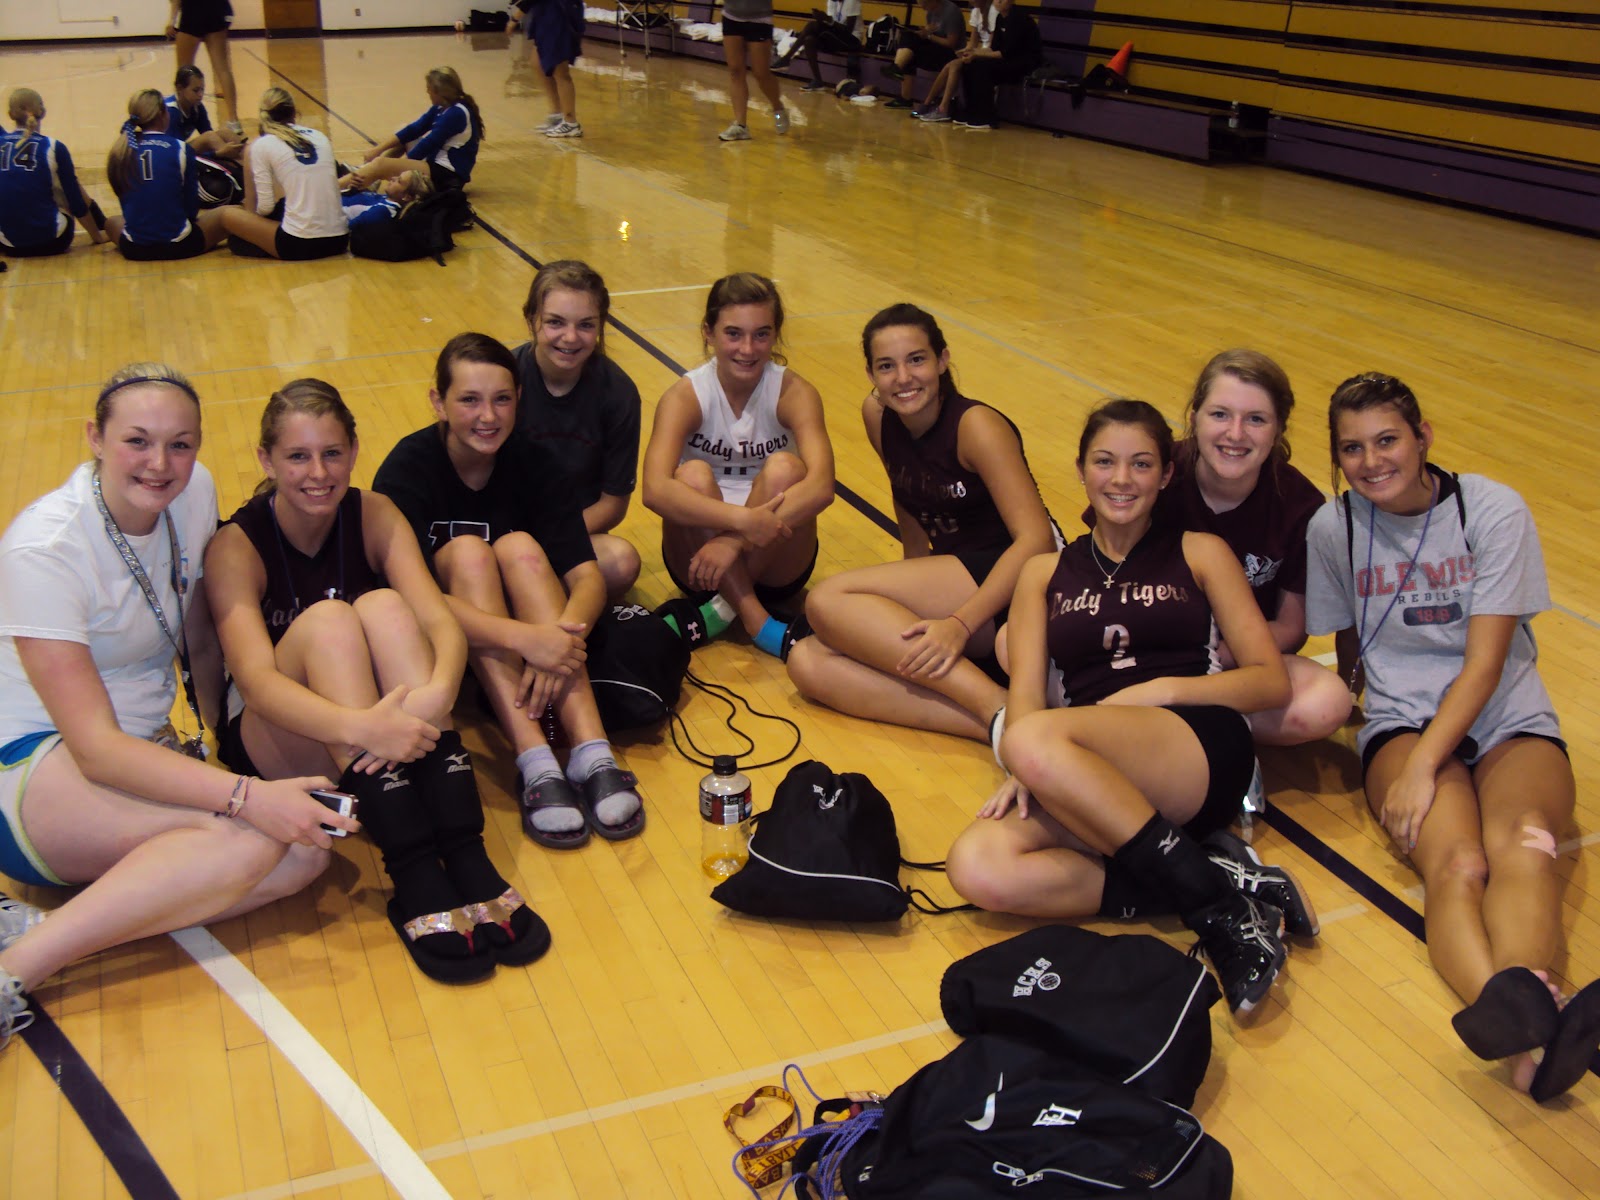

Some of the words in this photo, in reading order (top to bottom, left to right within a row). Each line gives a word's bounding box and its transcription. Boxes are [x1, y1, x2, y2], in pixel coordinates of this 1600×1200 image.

[1, 141, 39, 171] 14
[140, 149, 153, 180] 1
[688, 433, 733, 461] Lady
[738, 434, 789, 459] Tigers
[1356, 561, 1418, 598] OLE
[1420, 554, 1478, 590] MIS
[1050, 588, 1102, 620] Lady
[1119, 582, 1189, 607] Tigers
[1102, 624, 1137, 669] 2
